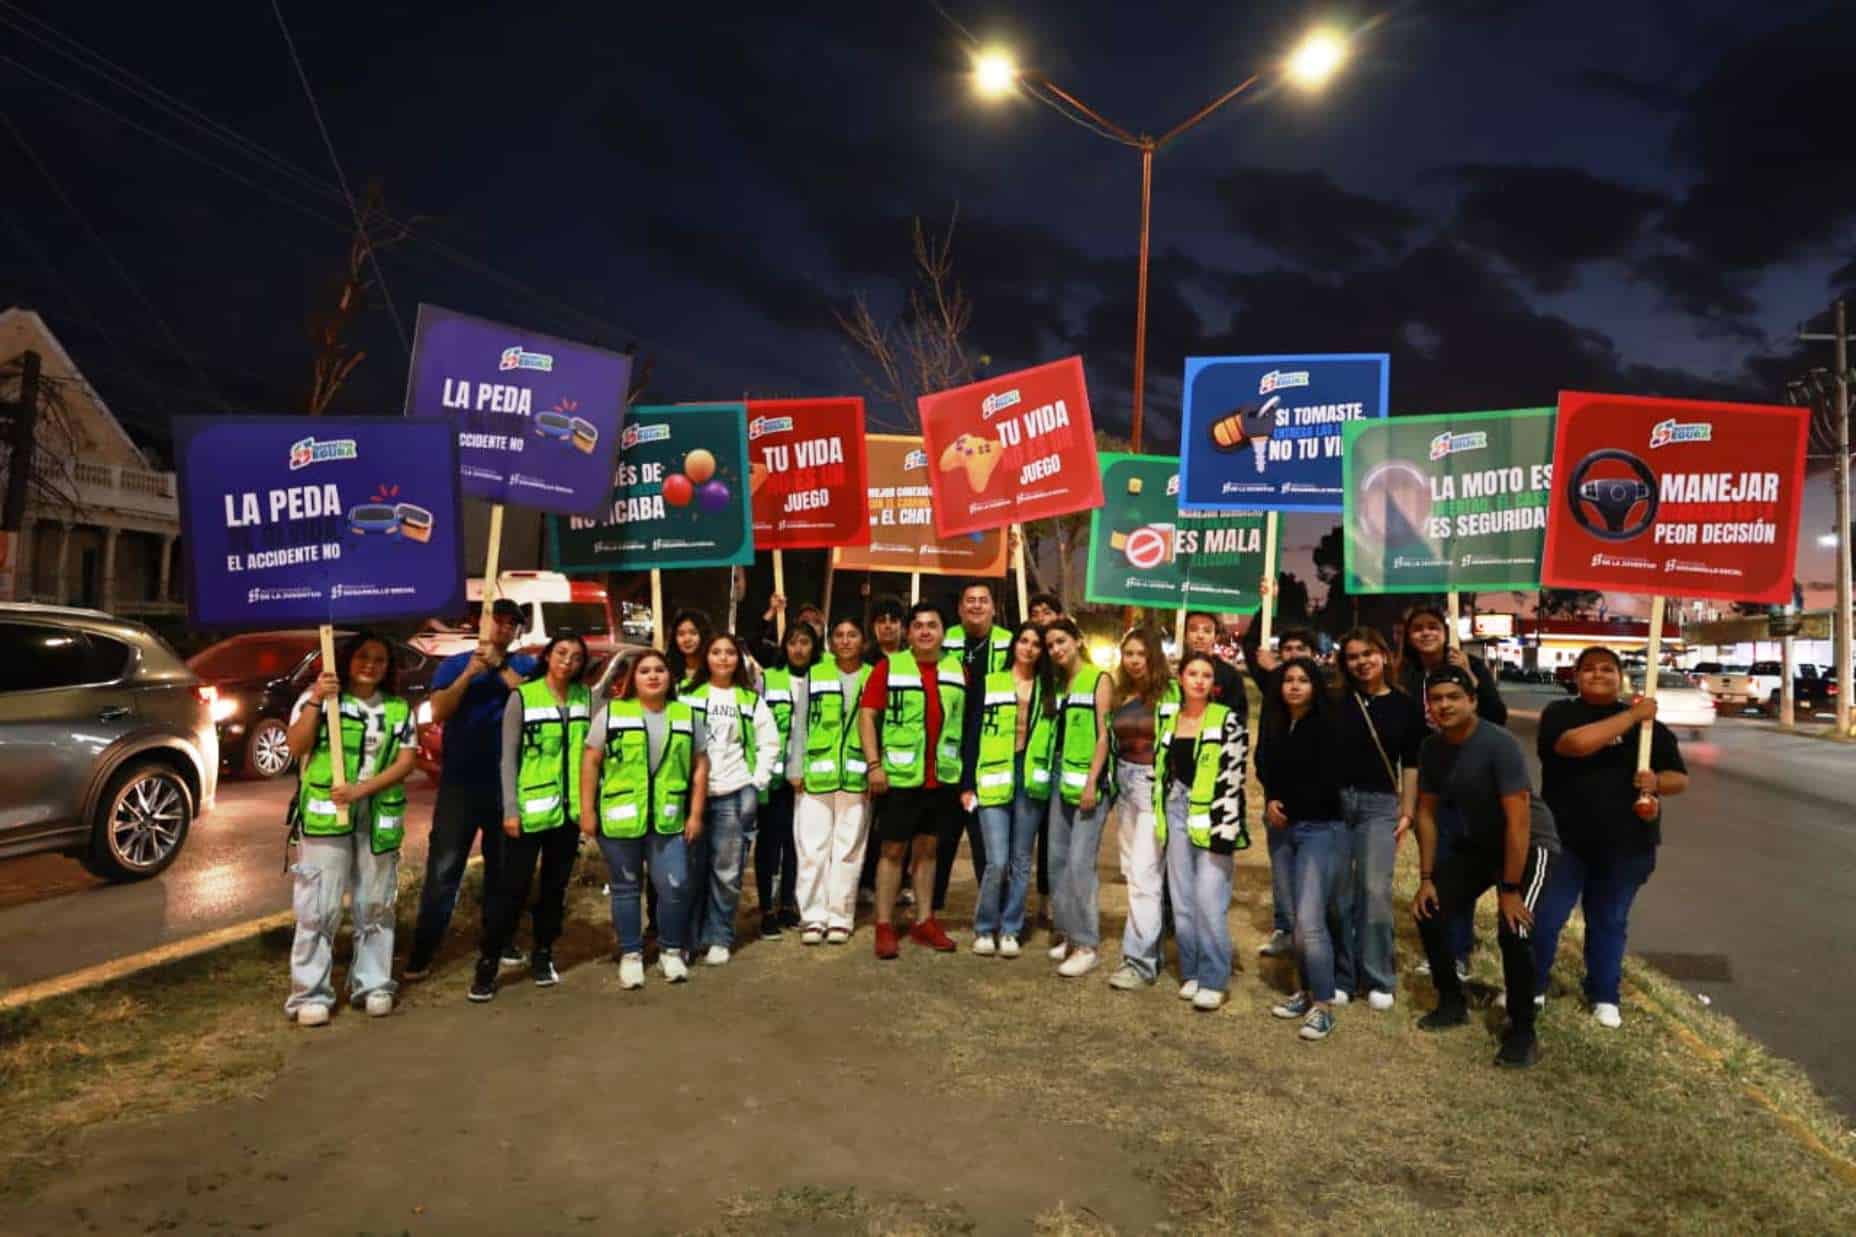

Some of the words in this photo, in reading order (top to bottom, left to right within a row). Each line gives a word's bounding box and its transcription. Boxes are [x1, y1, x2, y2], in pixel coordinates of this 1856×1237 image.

[443, 379, 470, 409] LA
[476, 382, 532, 416] PEDA
[995, 418, 1021, 448] TU
[1023, 400, 1070, 439] VIDA
[1275, 408, 1290, 427] SI
[459, 433, 507, 450] CCIDENTE
[510, 437, 524, 452] NO
[762, 446, 789, 473] TU
[794, 437, 844, 469] VIDA
[1269, 439, 1292, 461] NO
[1298, 438, 1320, 459] TU
[1324, 436, 1344, 457] VI
[642, 463, 663, 483] DE
[1020, 453, 1061, 485] JUEGO
[1430, 476, 1455, 501] LA
[1462, 467, 1524, 498] MOTO
[1531, 464, 1553, 489] ES
[784, 488, 830, 513] JUEGO
[1659, 473, 1780, 503] MANEJAR
[225, 492, 261, 528] LA
[270, 484, 341, 523] PEDA
[604, 495, 666, 525] CABA
[1429, 516, 1451, 539] ES
[1456, 507, 1549, 537] SEGURIDA
[1654, 523, 1697, 544] PEOR
[1701, 517, 1776, 544] DECISIÓN
[1176, 530, 1198, 553] ES
[1204, 528, 1261, 553] MALA
[227, 555, 243, 571] EL
[247, 545, 318, 570] ACCIDENTE
[322, 543, 341, 560] NO
